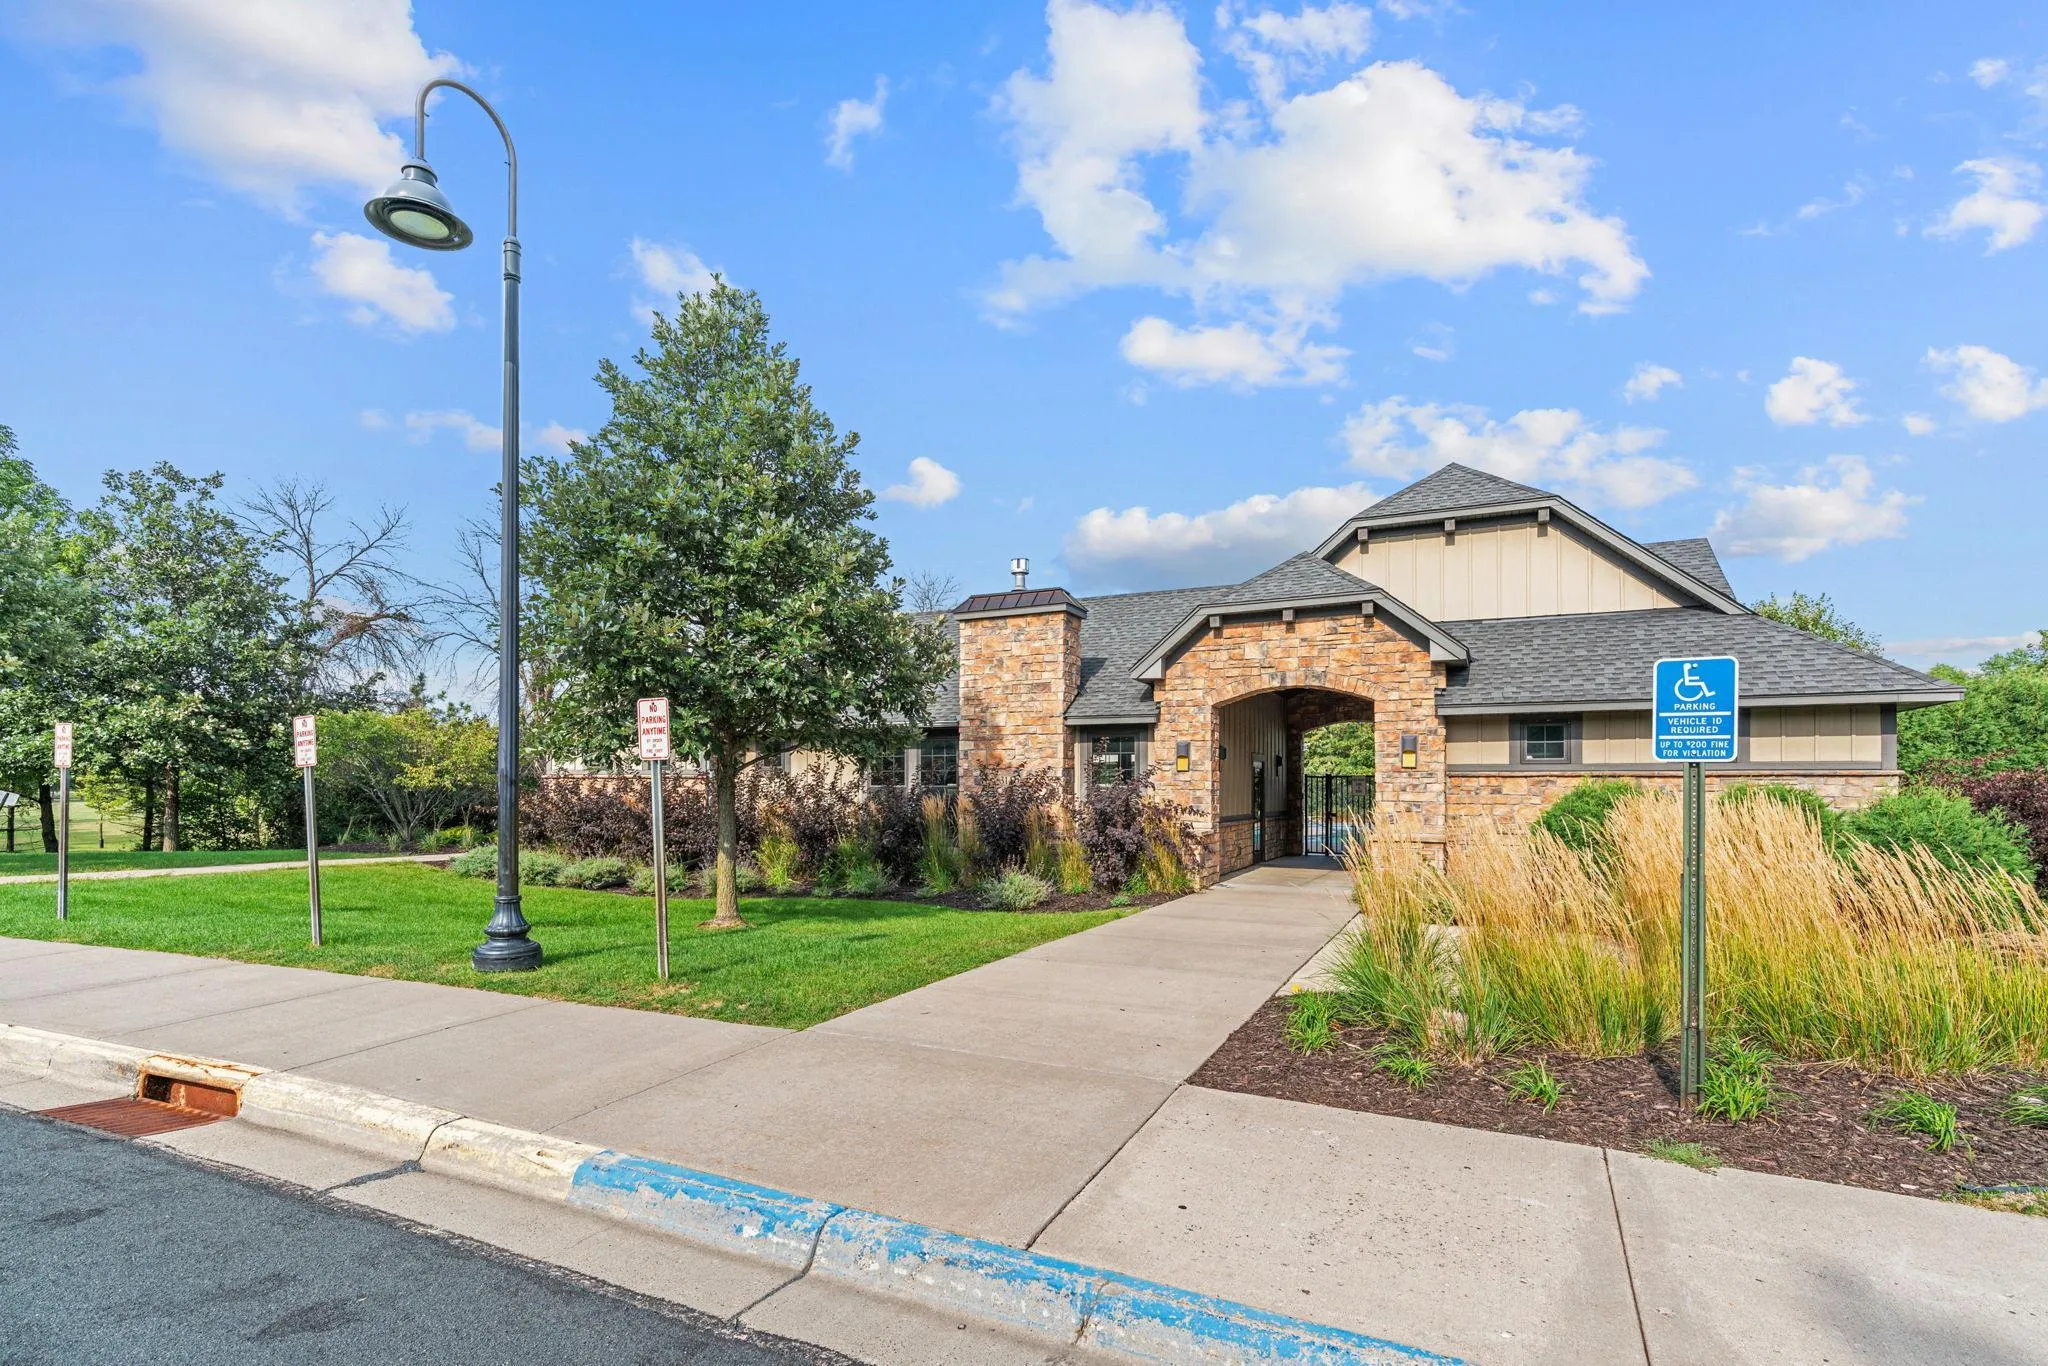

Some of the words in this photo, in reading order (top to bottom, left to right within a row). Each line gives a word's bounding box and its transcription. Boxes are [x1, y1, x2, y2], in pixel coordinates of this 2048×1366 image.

[649, 704, 658, 713] NO
[1674, 703, 1716, 711] PARKING
[641, 715, 666, 724] PARKING
[1668, 717, 1707, 725] VEHICLE
[1712, 717, 1722, 725] ID
[642, 727, 666, 735] ANYTIME
